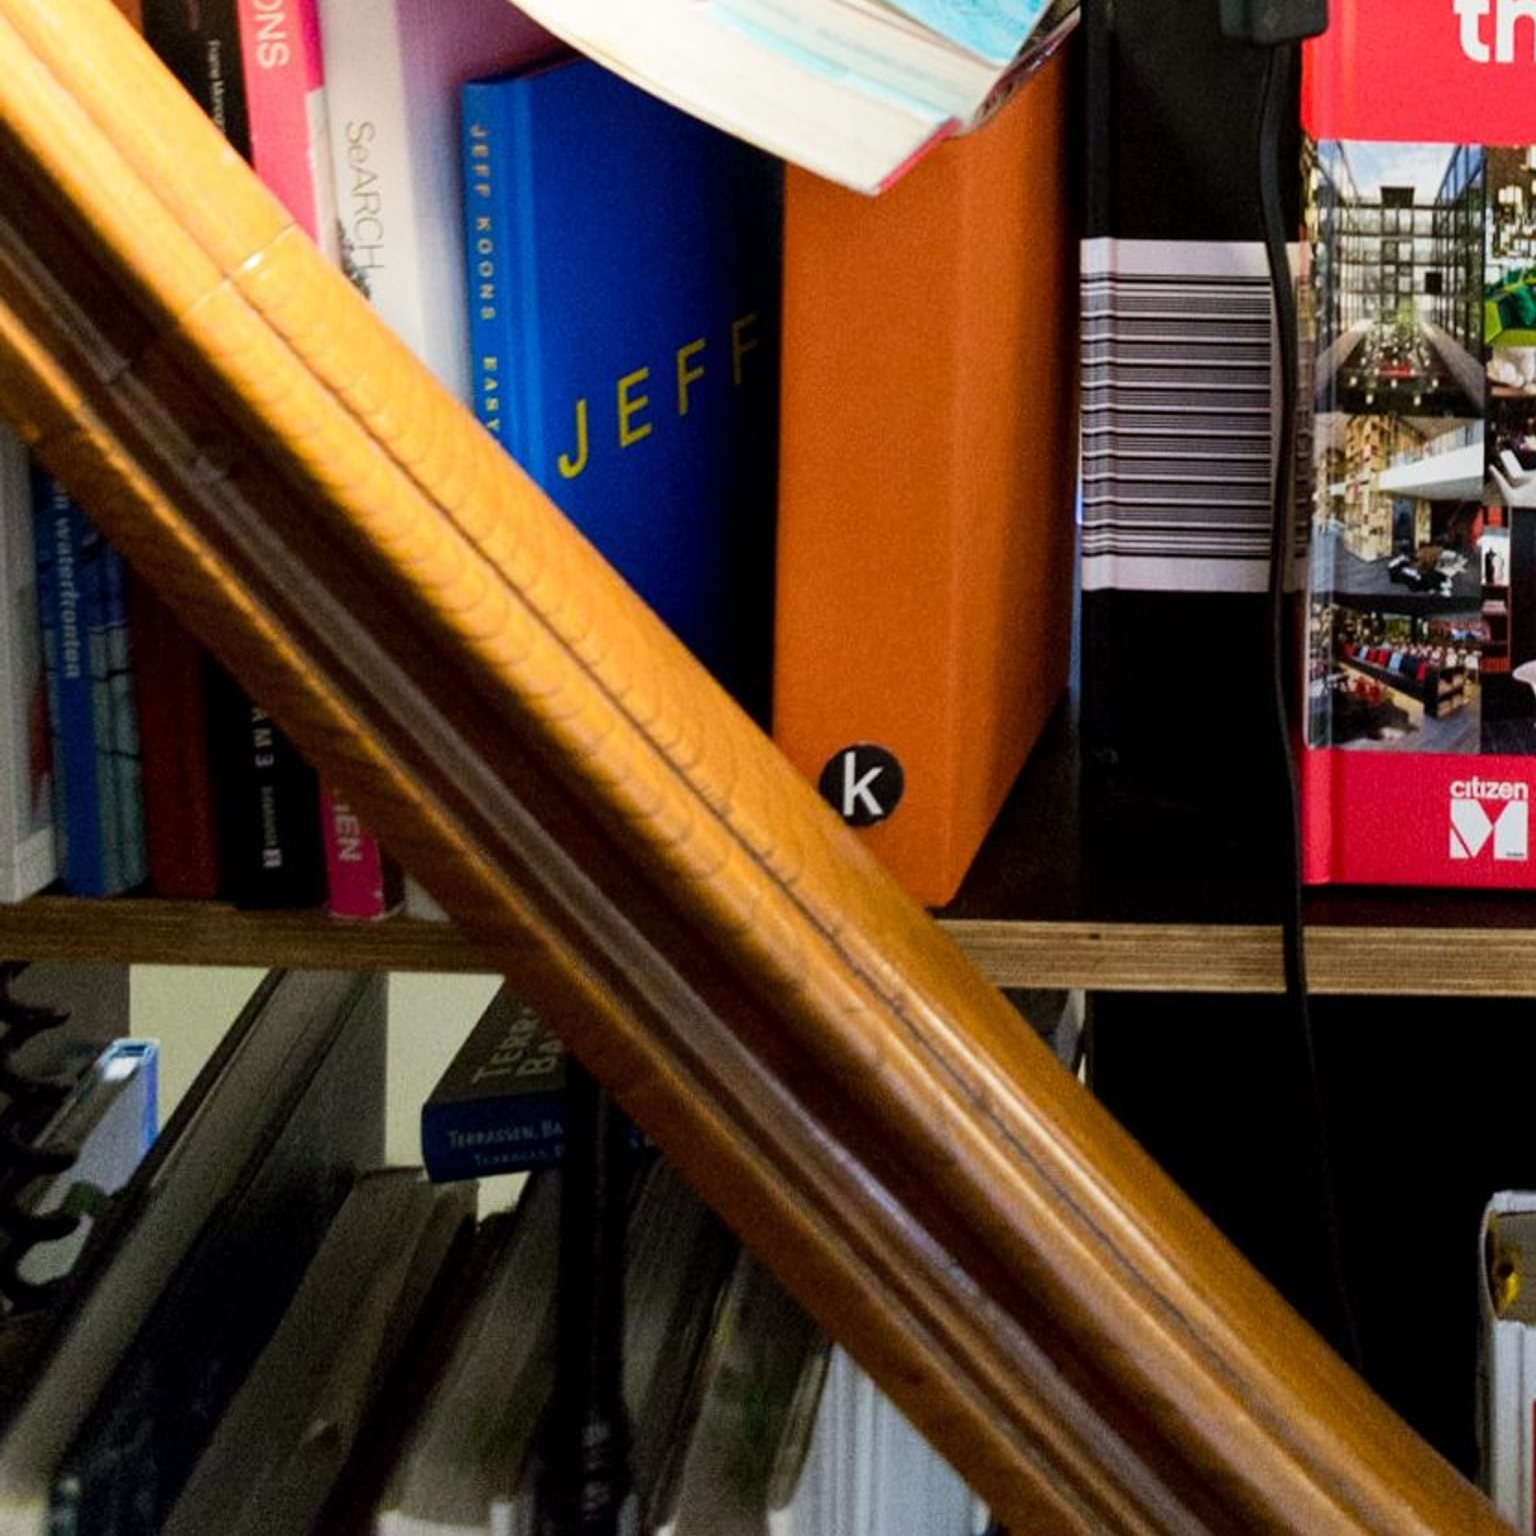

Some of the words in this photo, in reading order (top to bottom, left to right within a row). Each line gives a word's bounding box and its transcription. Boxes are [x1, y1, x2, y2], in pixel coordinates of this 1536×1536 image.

[343, 119, 387, 271] SeARCH
[469, 123, 491, 199] JEFF
[475, 214, 496, 322] KOONS
[555, 309, 760, 480] JEFF
[55, 517, 80, 679] waterfronten
[841, 752, 885, 818] k
[1448, 800, 1529, 860] M
[1449, 776, 1530, 801] citizen
